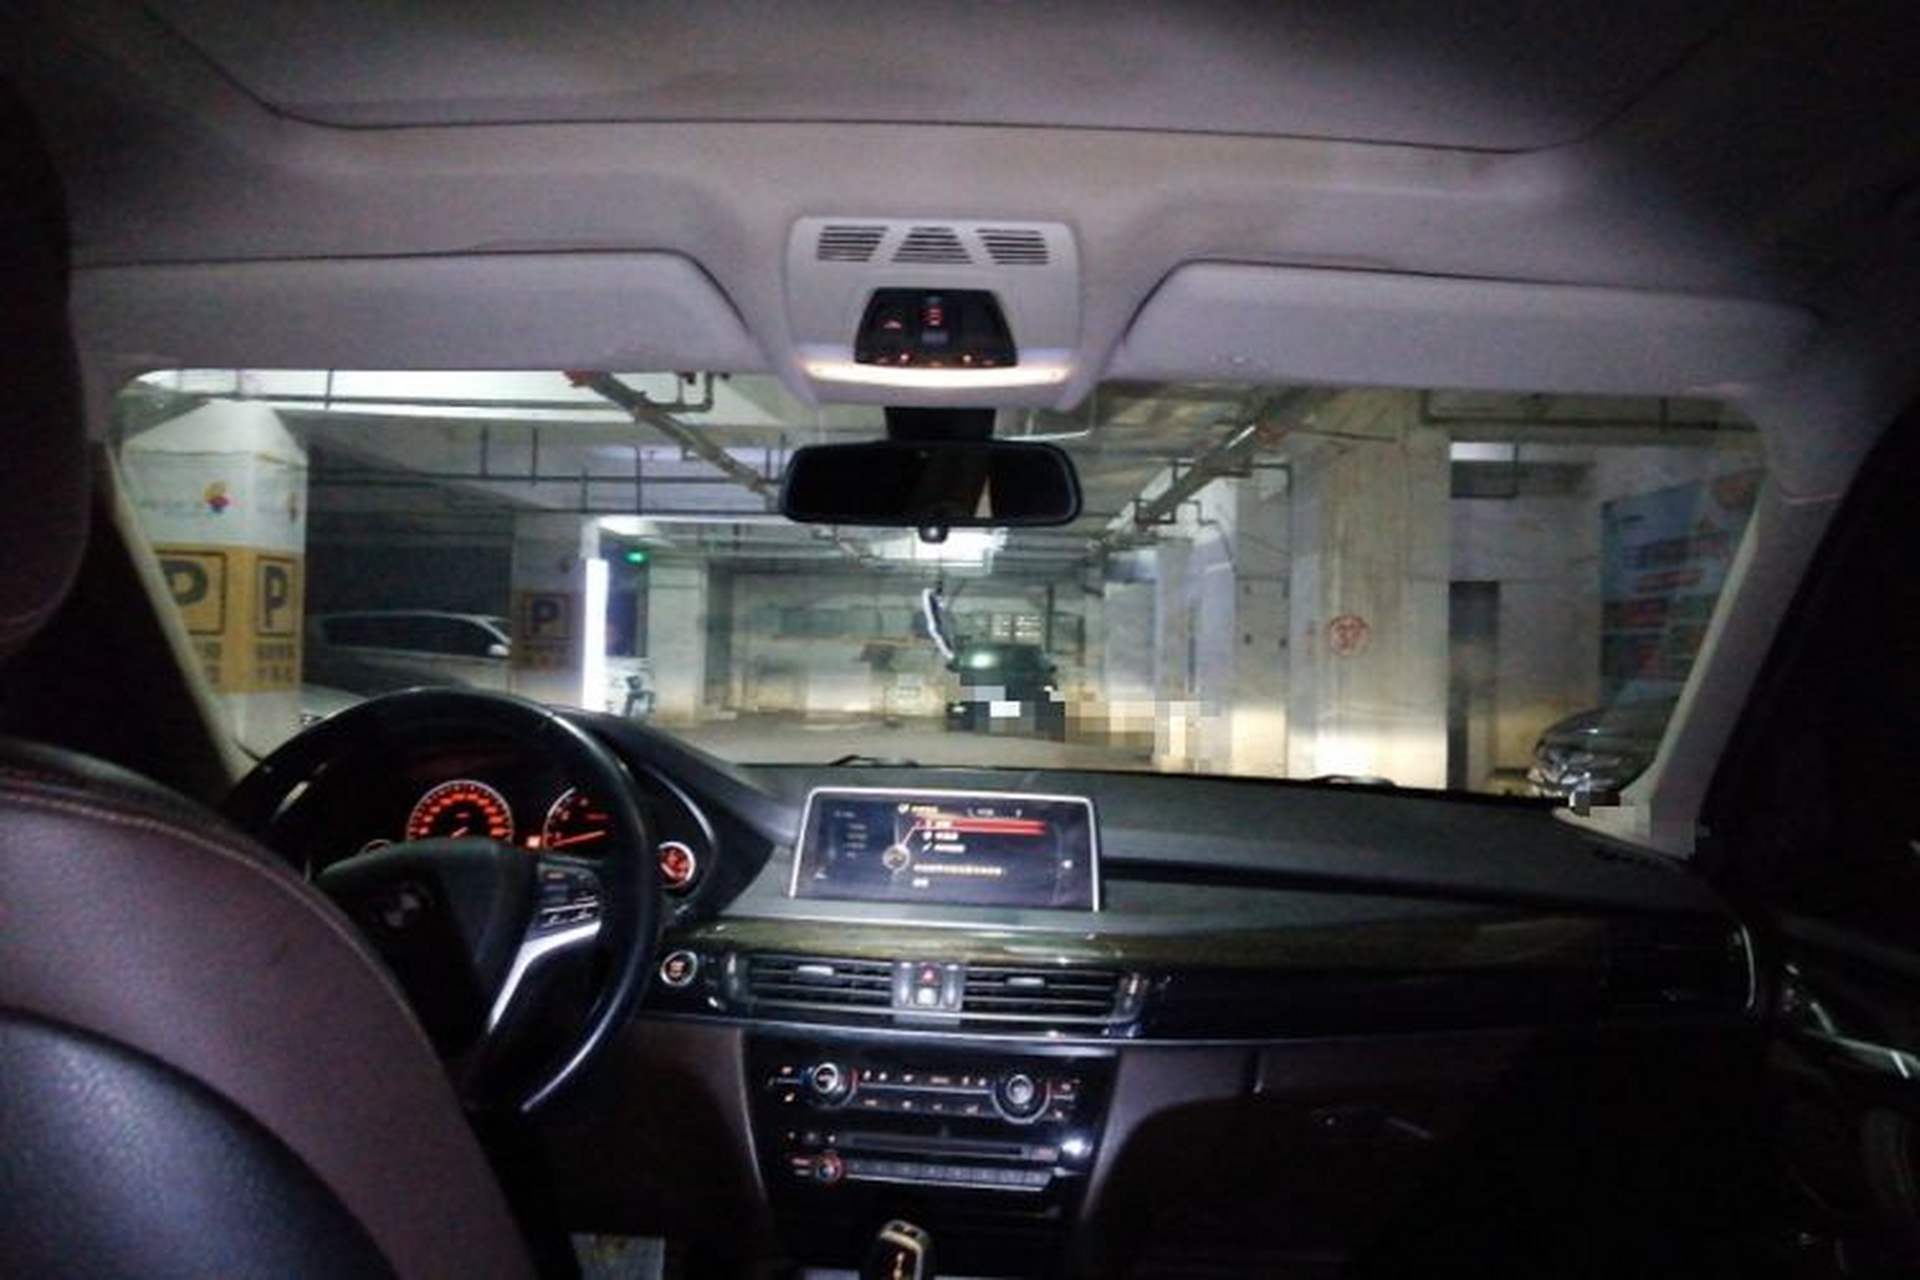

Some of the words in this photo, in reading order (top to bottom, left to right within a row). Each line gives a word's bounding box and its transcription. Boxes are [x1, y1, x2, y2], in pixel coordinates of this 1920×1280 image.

[160, 560, 208, 606] P
[264, 565, 289, 629] P
[533, 600, 560, 635] P
